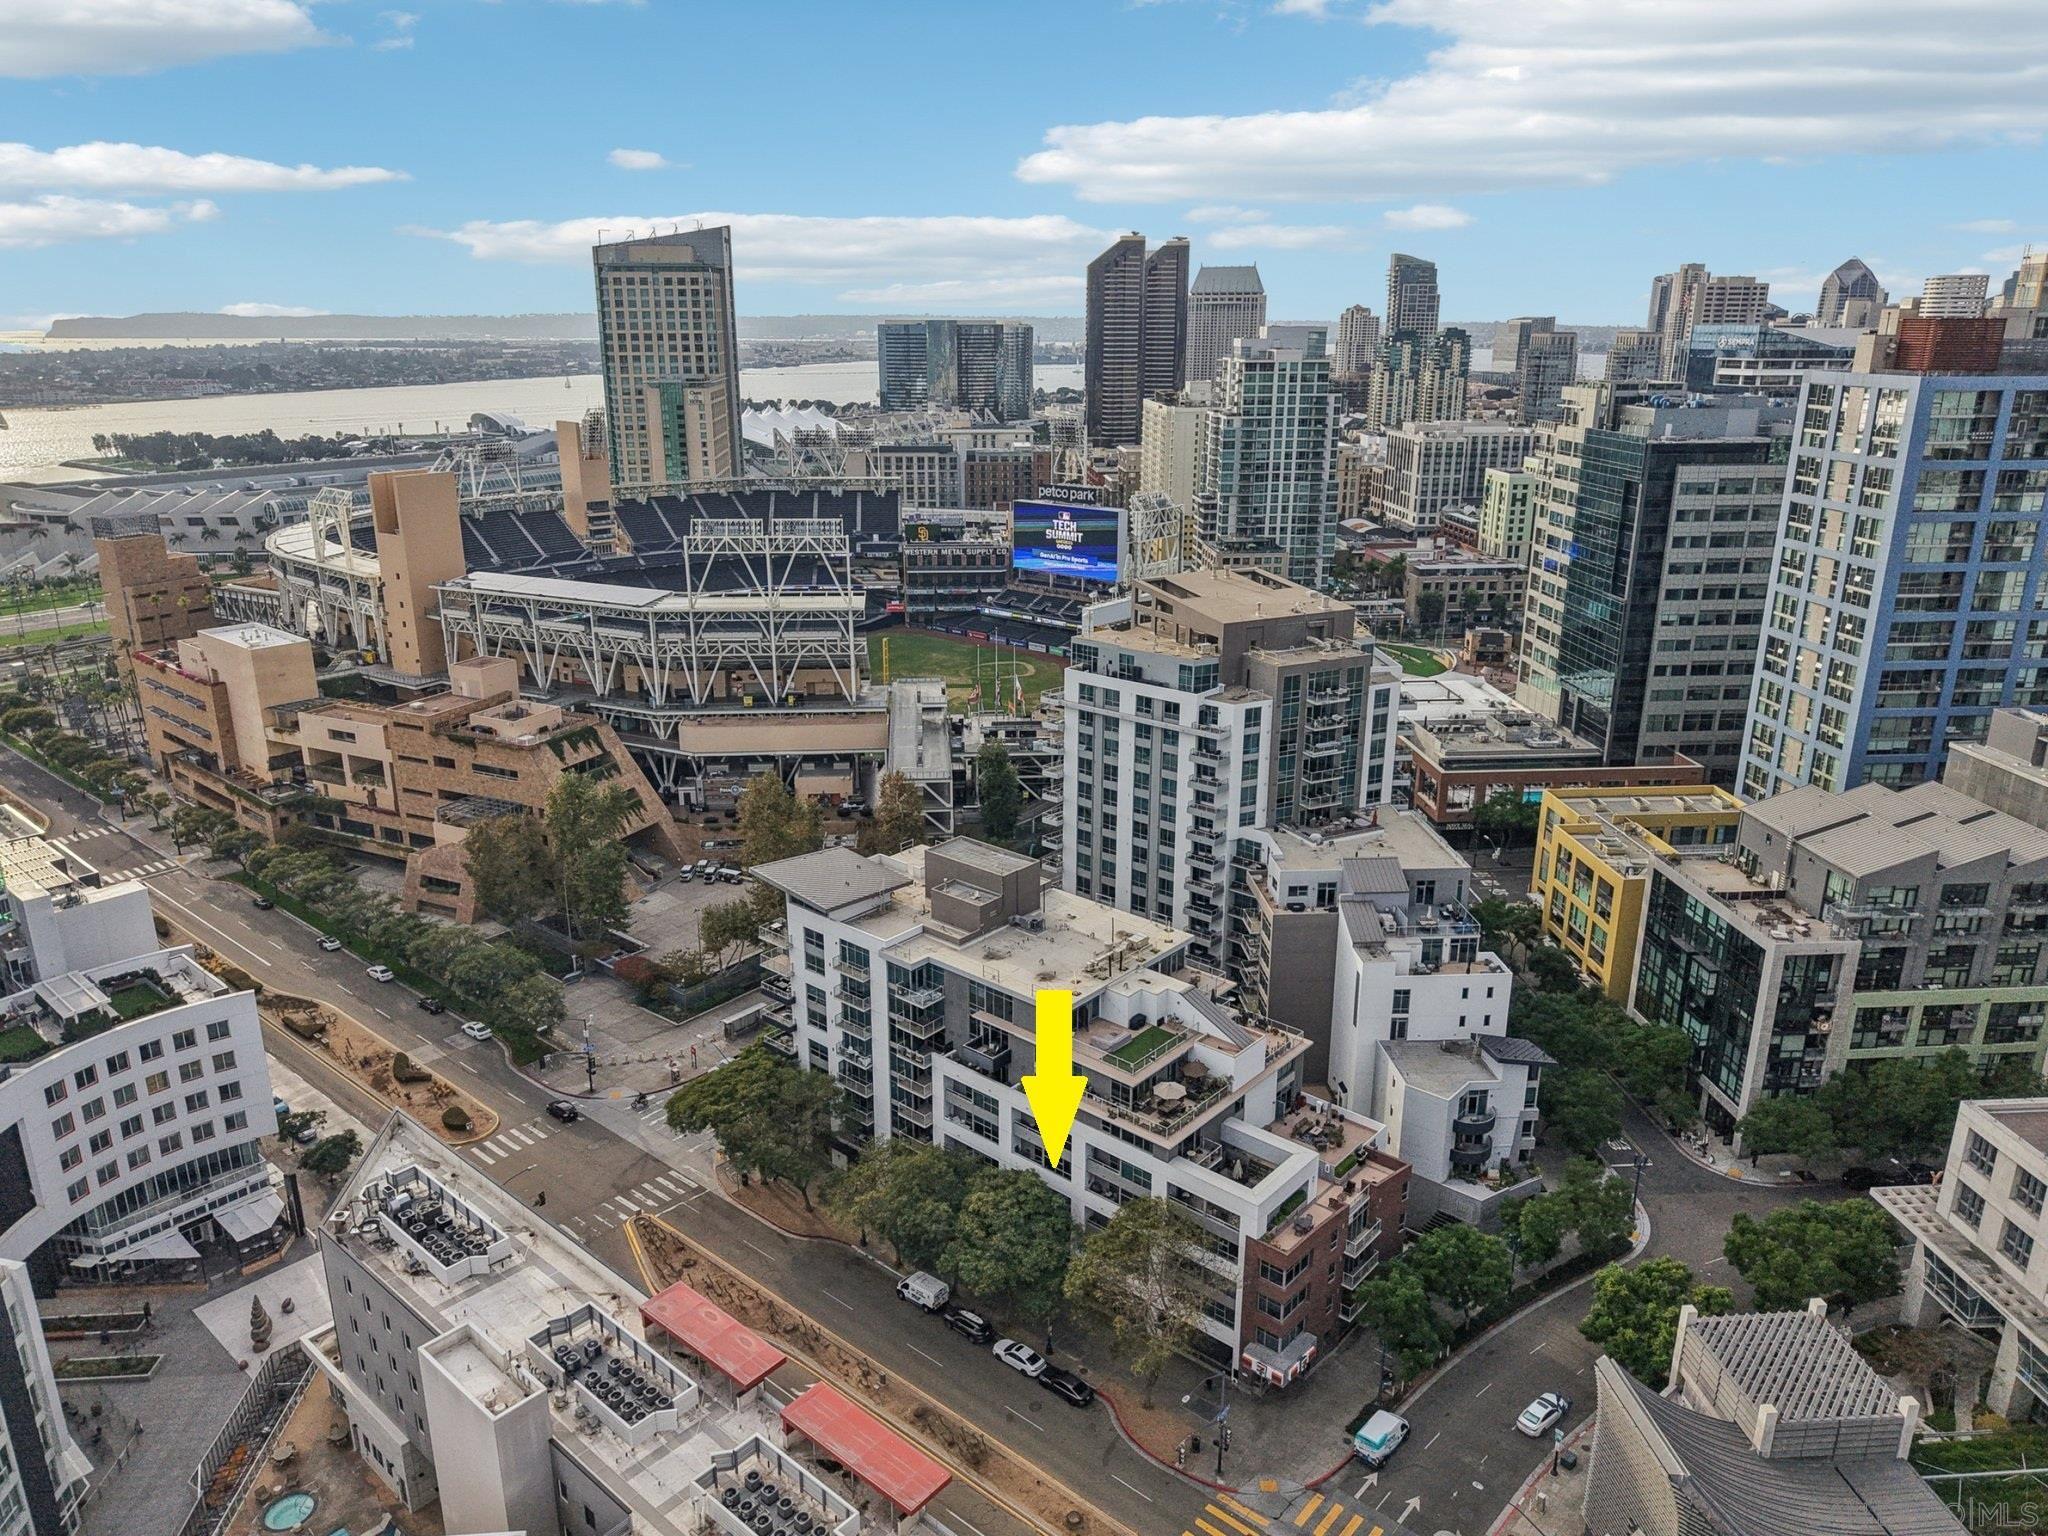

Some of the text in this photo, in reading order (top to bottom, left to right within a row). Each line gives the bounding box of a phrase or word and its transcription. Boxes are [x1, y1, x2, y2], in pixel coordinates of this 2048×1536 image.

[1038, 486, 1094, 501] petco park
[1052, 520, 1077, 531] TECH
[1045, 529, 1083, 543] SUMMIT
[904, 548, 938, 556] WESTERN
[941, 548, 964, 556] METAL
[966, 548, 993, 556] SUPPLY
